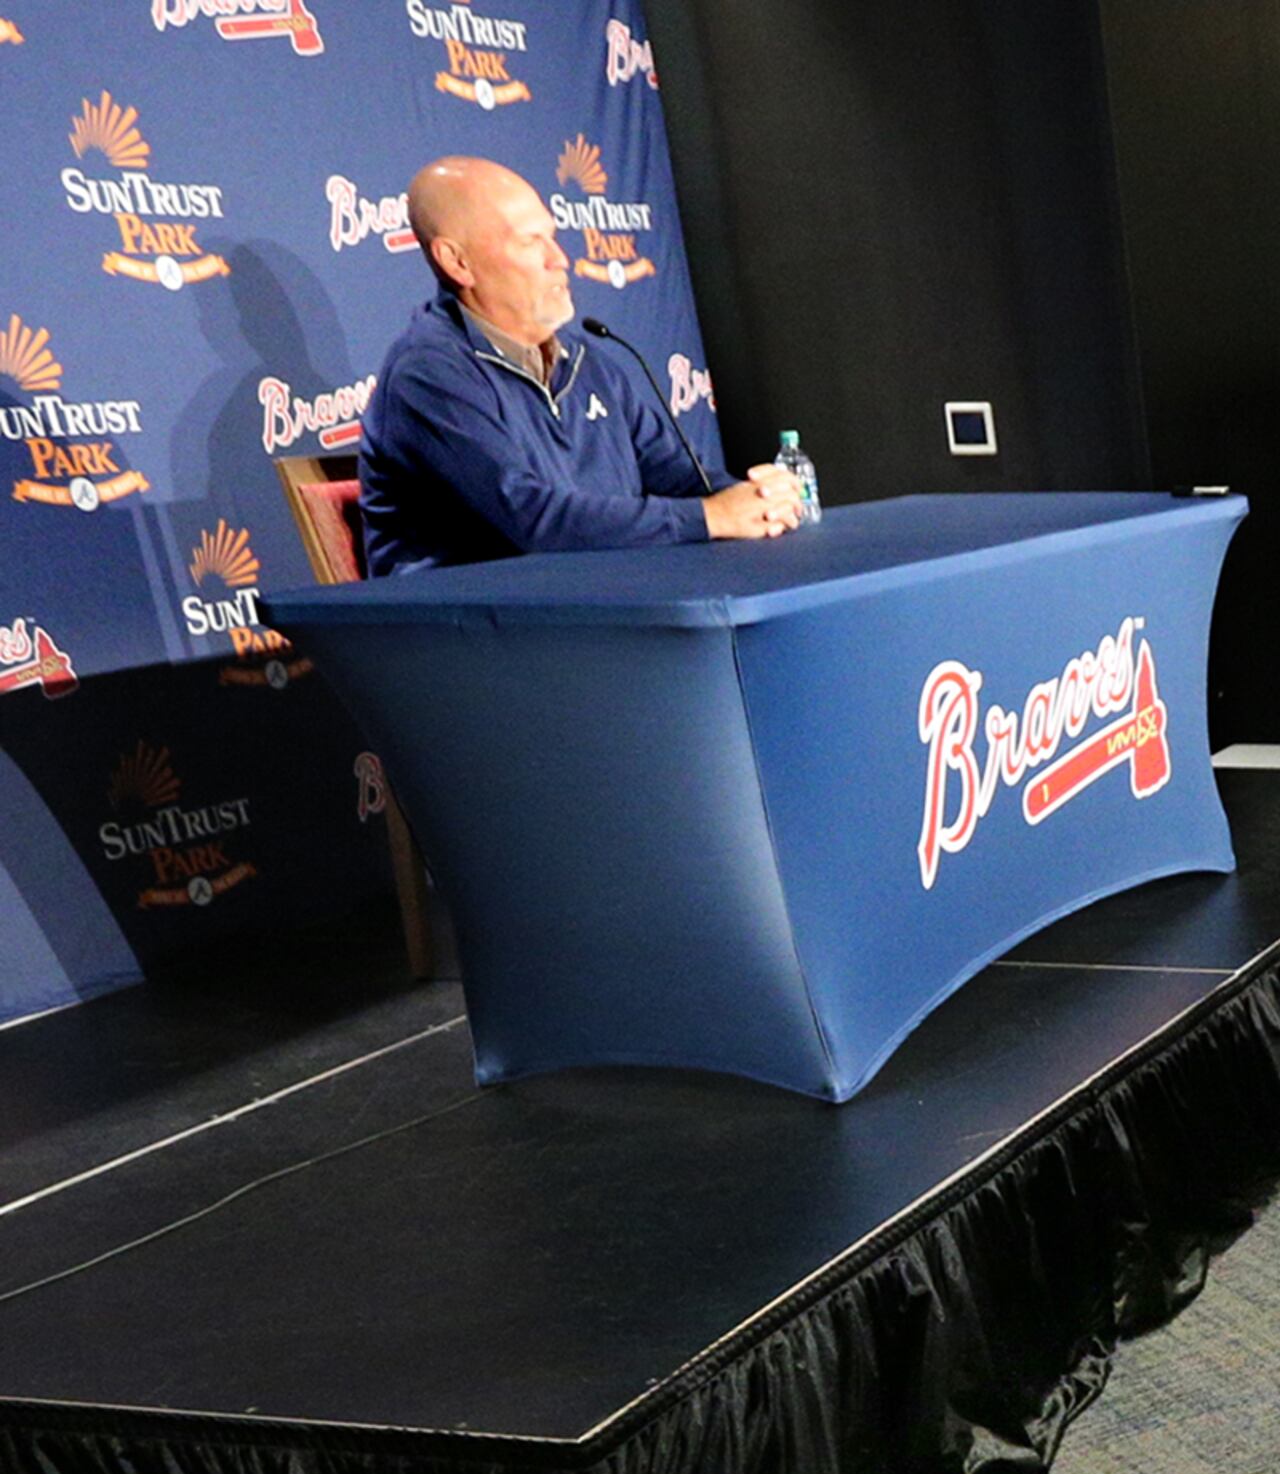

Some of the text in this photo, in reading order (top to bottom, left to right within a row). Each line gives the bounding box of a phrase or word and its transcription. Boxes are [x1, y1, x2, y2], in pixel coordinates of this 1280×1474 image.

[446, 38, 511, 80] PARK
[61, 168, 224, 217] SUNTRUST
[113, 211, 203, 255] PARK
[583, 227, 637, 260] PARK
[0, 395, 142, 440] UNTRUST
[25, 437, 121, 479] PARK
[181, 588, 260, 635] SUNT
[917, 617, 1134, 890] Braves
[150, 842, 232, 884] PARK
